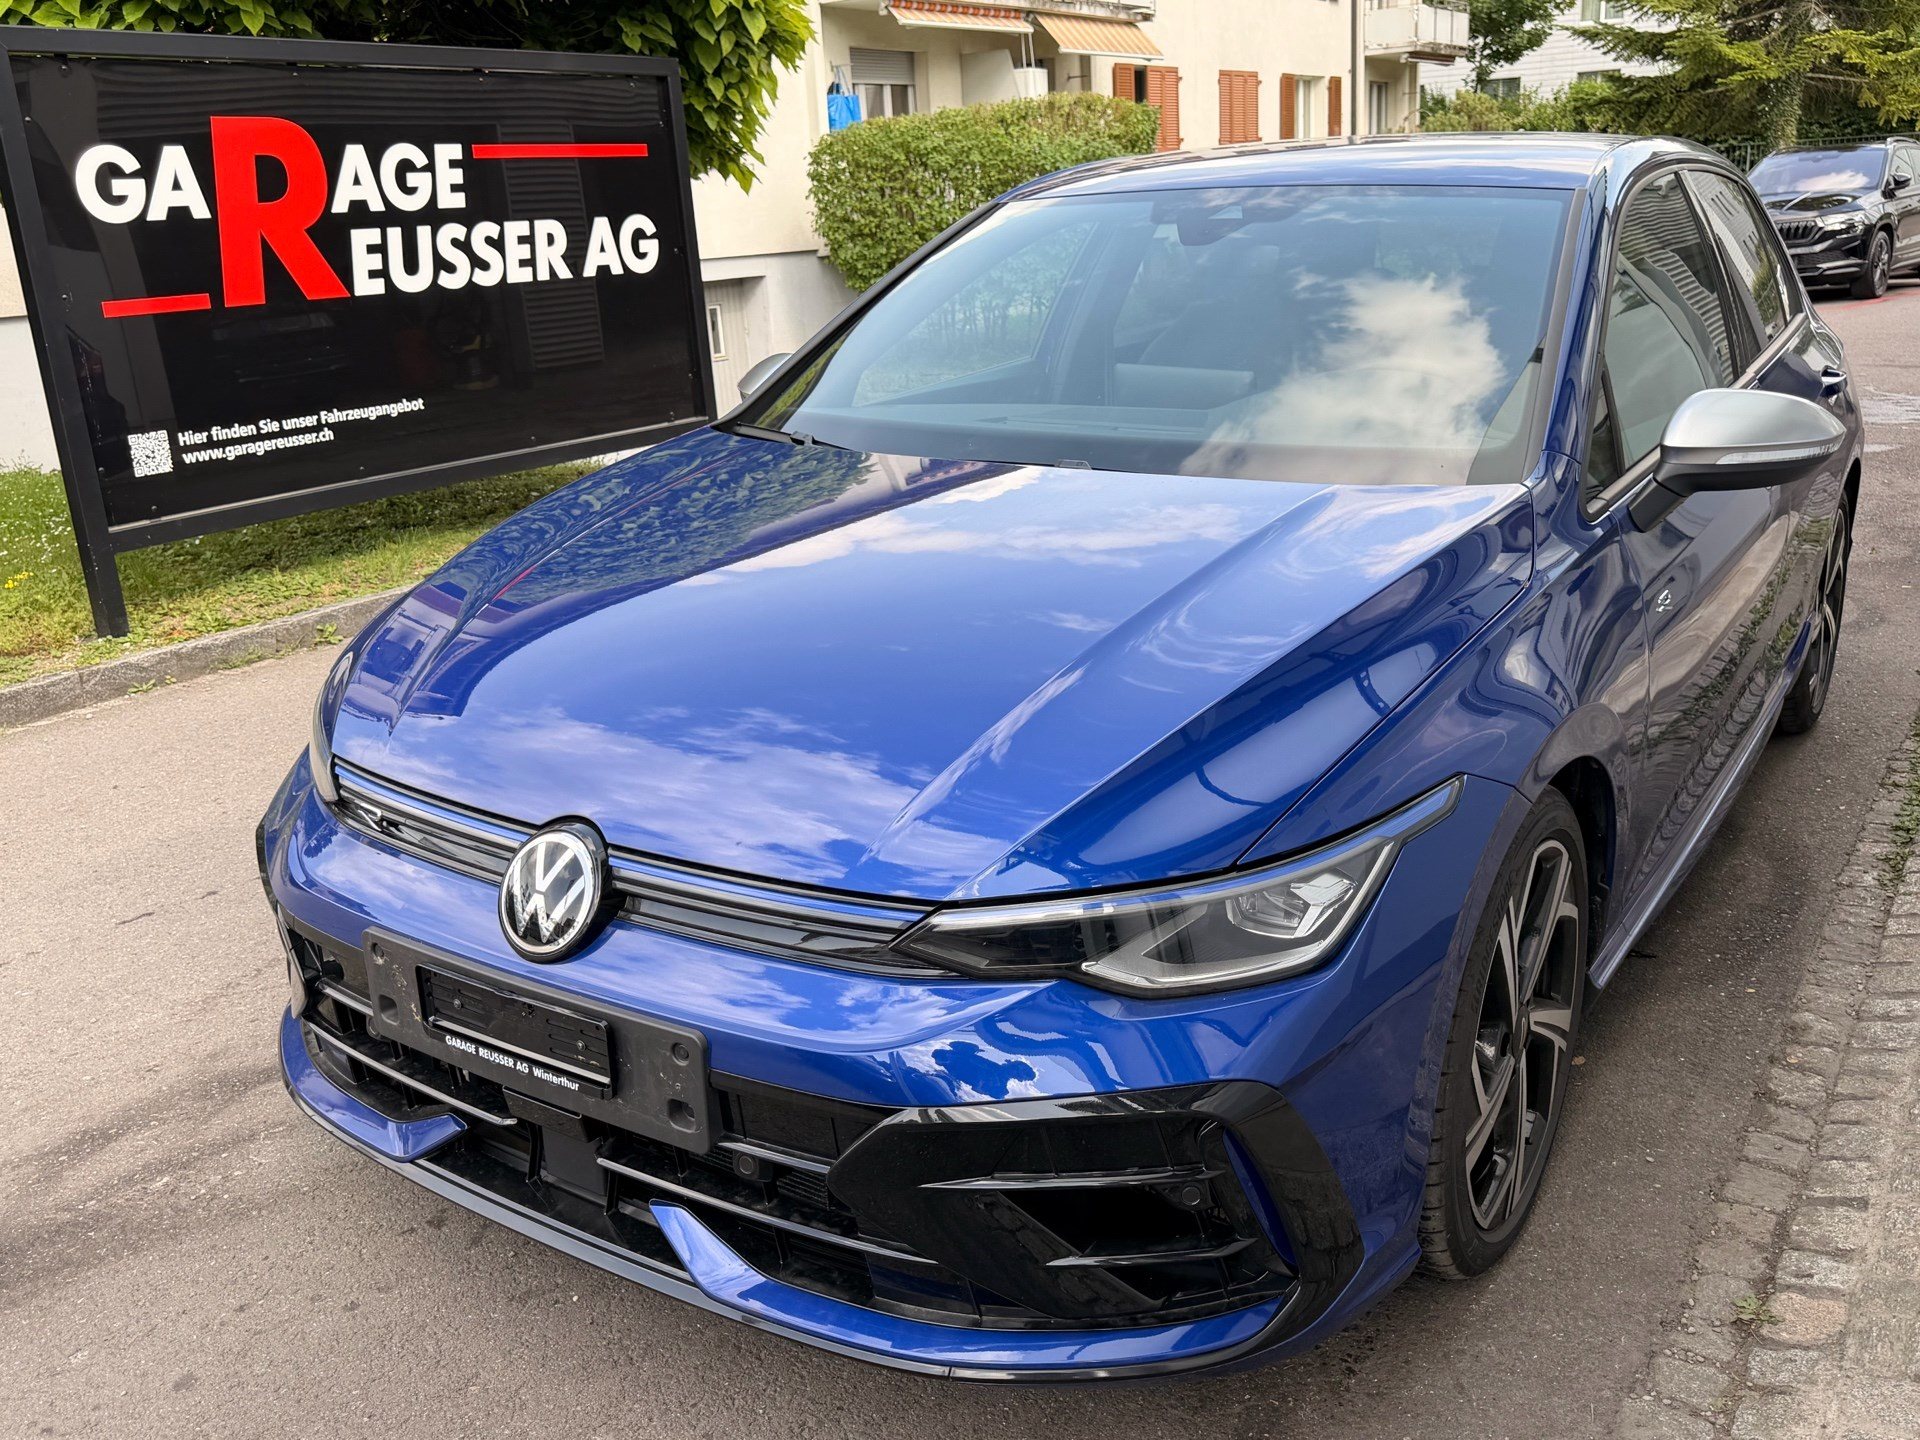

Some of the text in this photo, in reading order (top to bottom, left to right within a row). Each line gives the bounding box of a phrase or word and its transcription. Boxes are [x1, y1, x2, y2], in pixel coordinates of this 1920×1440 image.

[583, 213, 659, 278] AG
[178, 398, 424, 446] Hier finden Sie unser Fahrzeugangebot
[182, 427, 334, 464] www.garagereusser.ch
[445, 1035, 579, 1091] GARAGE REUSSER AG Winterthur
